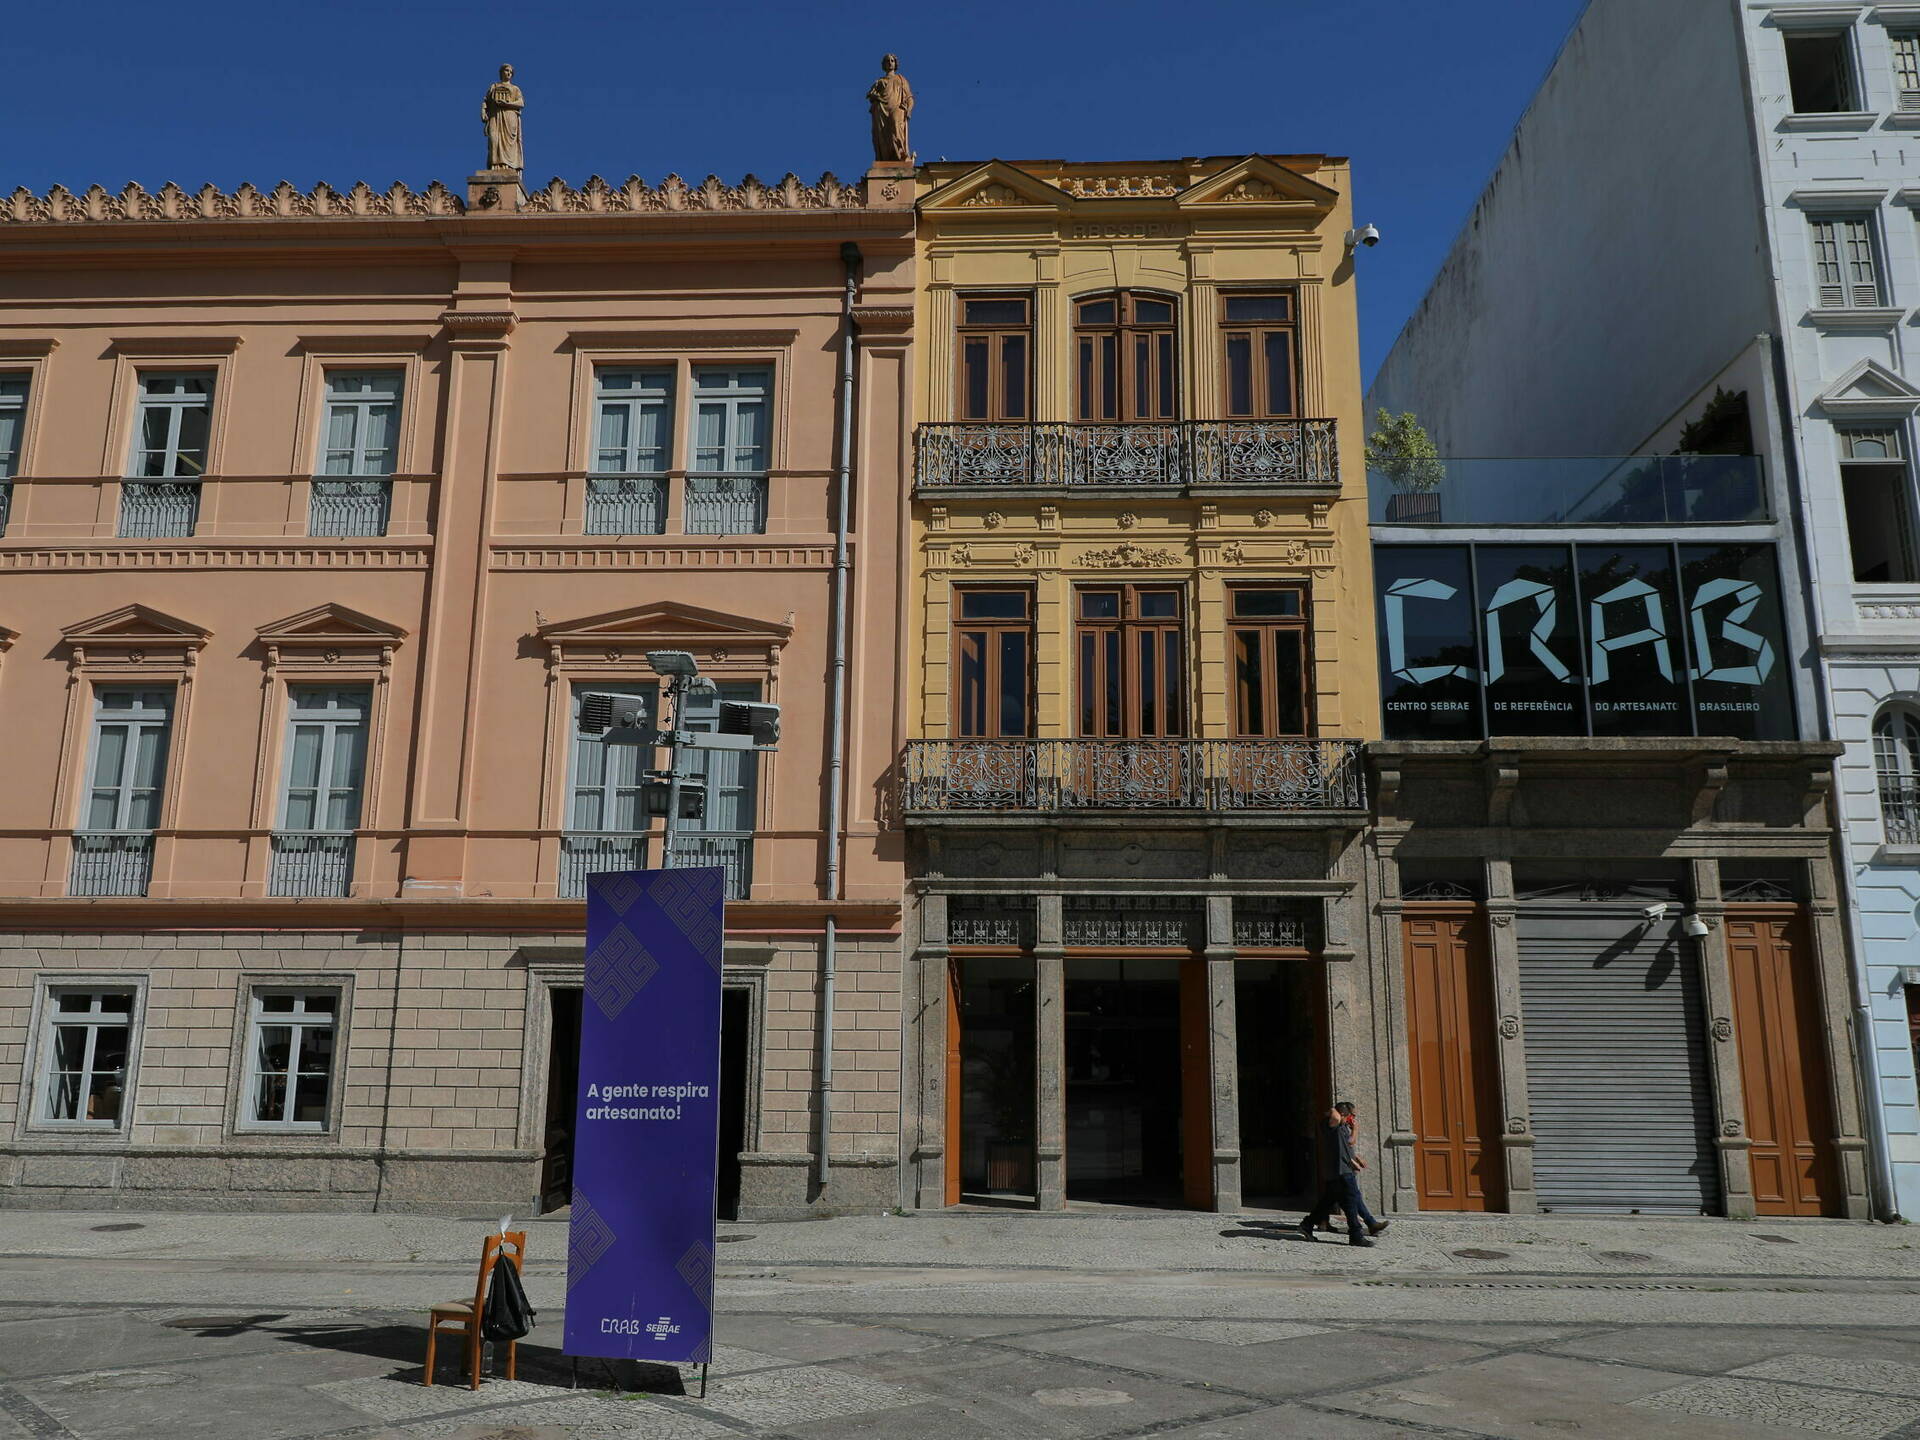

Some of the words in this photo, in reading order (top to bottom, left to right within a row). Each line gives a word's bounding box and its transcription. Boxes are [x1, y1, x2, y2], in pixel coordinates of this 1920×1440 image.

[1385, 578, 1775, 686] CRAB
[1387, 702, 1427, 711] CENTRO
[1430, 702, 1470, 711] SEBRAE
[1494, 702, 1507, 711] DE
[1510, 701, 1573, 711] REFERÊNCIA
[1595, 702, 1609, 711] DO
[1612, 702, 1680, 711] ARTESANATO
[1700, 702, 1760, 711] BRASILEIRO
[586, 1083, 598, 1096] A
[602, 1083, 648, 1101] gente
[652, 1081, 708, 1101] respira
[586, 1105, 681, 1119] artesanato!
[601, 1318, 640, 1334] CRAB
[646, 1323, 680, 1334] SEBRAE
